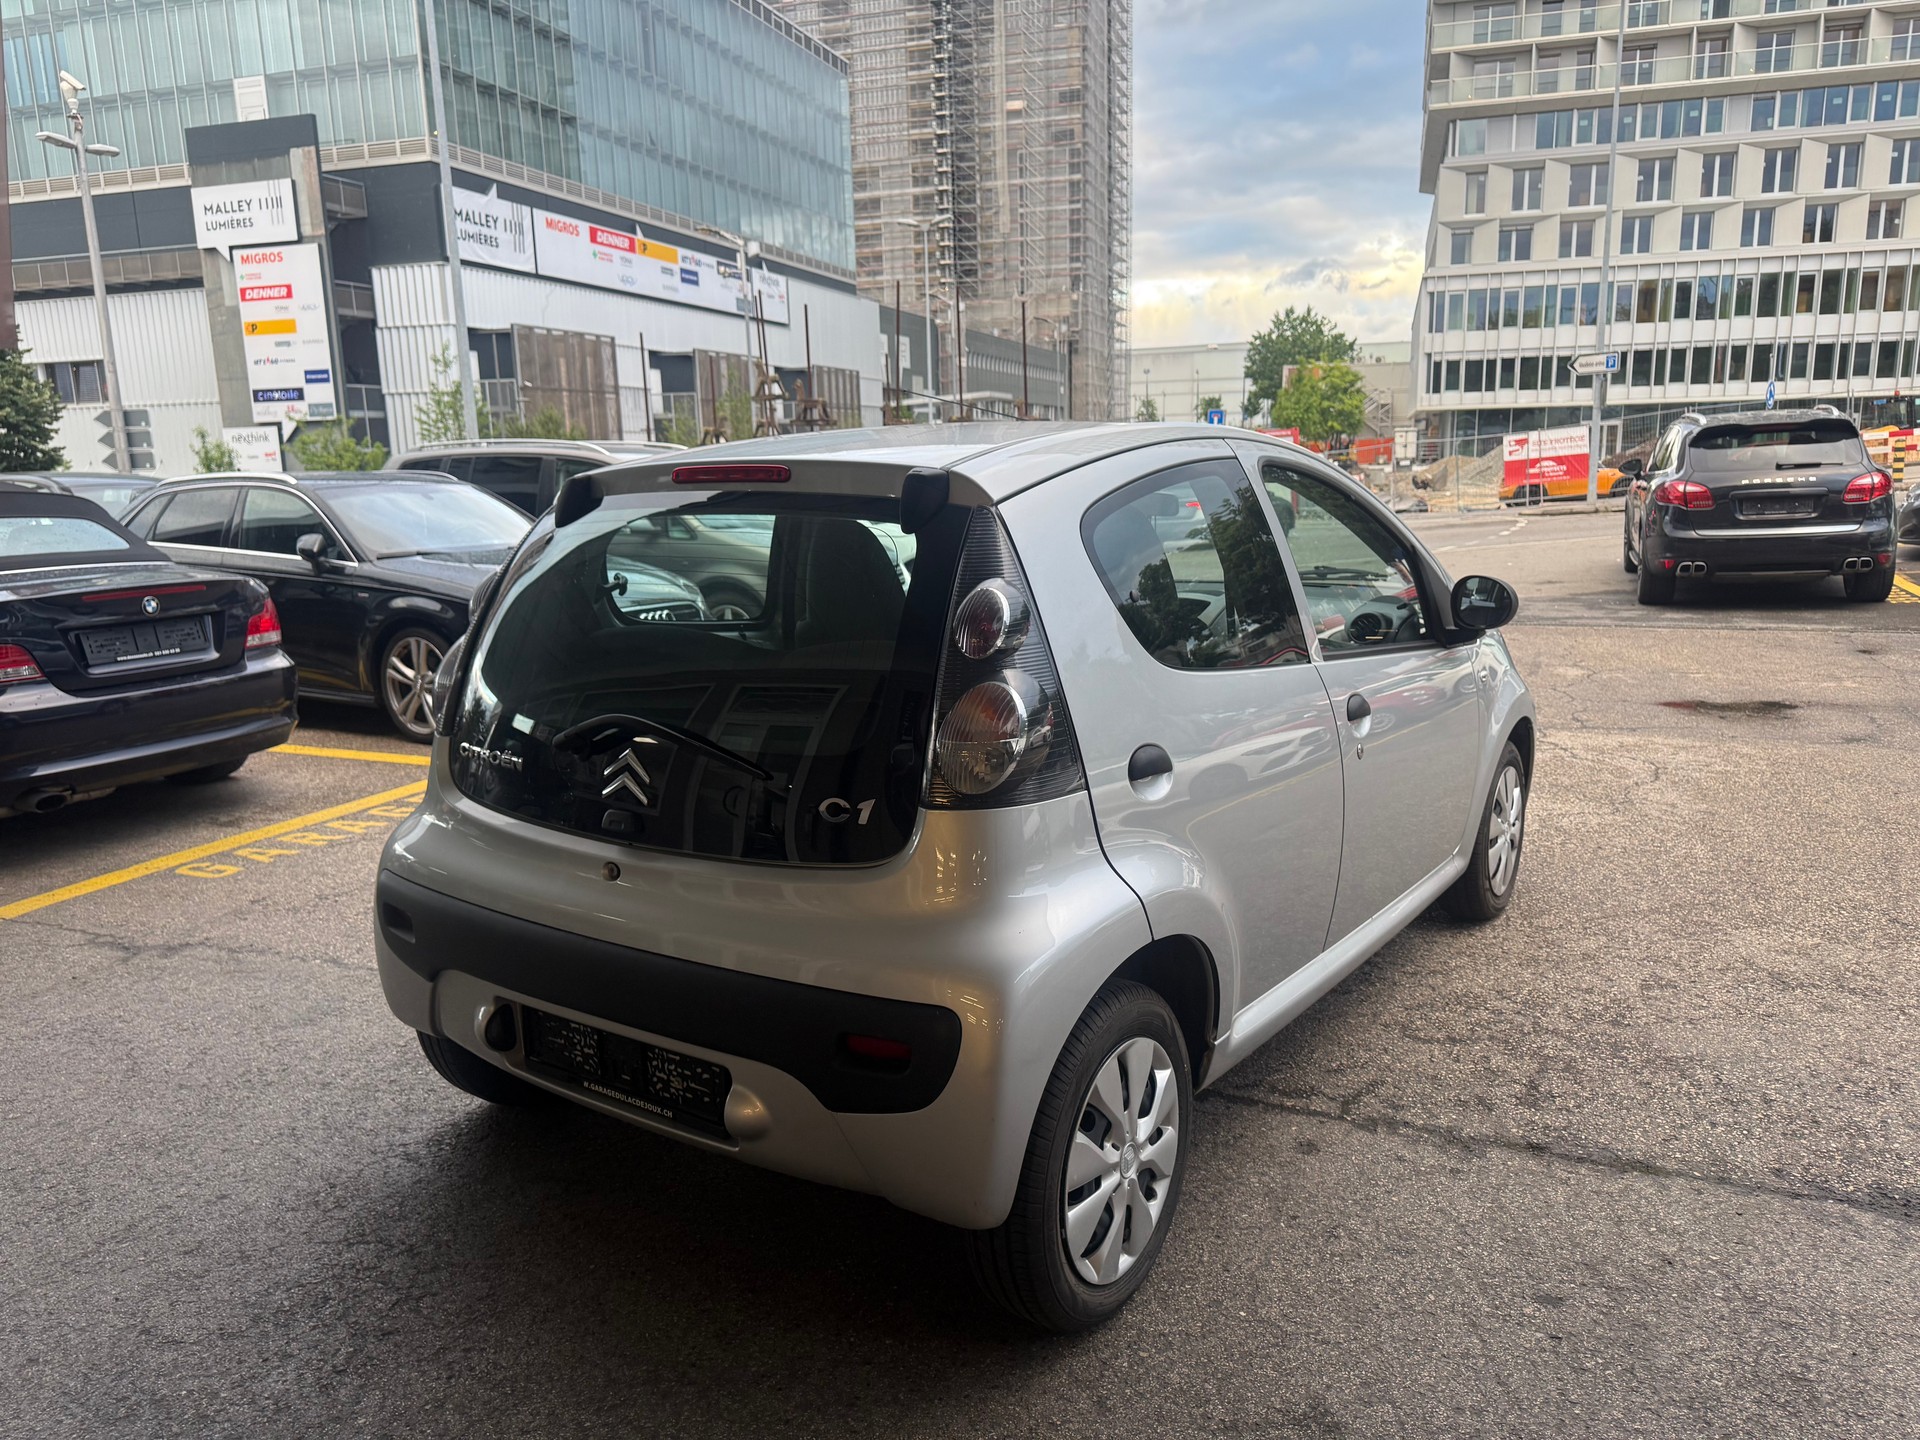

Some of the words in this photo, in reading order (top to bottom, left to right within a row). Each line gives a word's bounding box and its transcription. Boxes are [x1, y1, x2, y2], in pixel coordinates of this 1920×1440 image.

[204, 198, 252, 215] MALLEY
[205, 216, 254, 231] LUMIÈRES
[454, 208, 499, 230] MALLEY
[545, 216, 580, 237] MIGROS
[457, 229, 499, 248] UMIÈRES
[596, 231, 630, 250] DENNER
[240, 251, 284, 265] MIGROS
[245, 286, 288, 299] DENNER
[1741, 476, 1817, 485] PORSCHE
[460, 741, 523, 771] CITROËN
[818, 797, 876, 826] C1
[175, 792, 426, 879] GARAG
